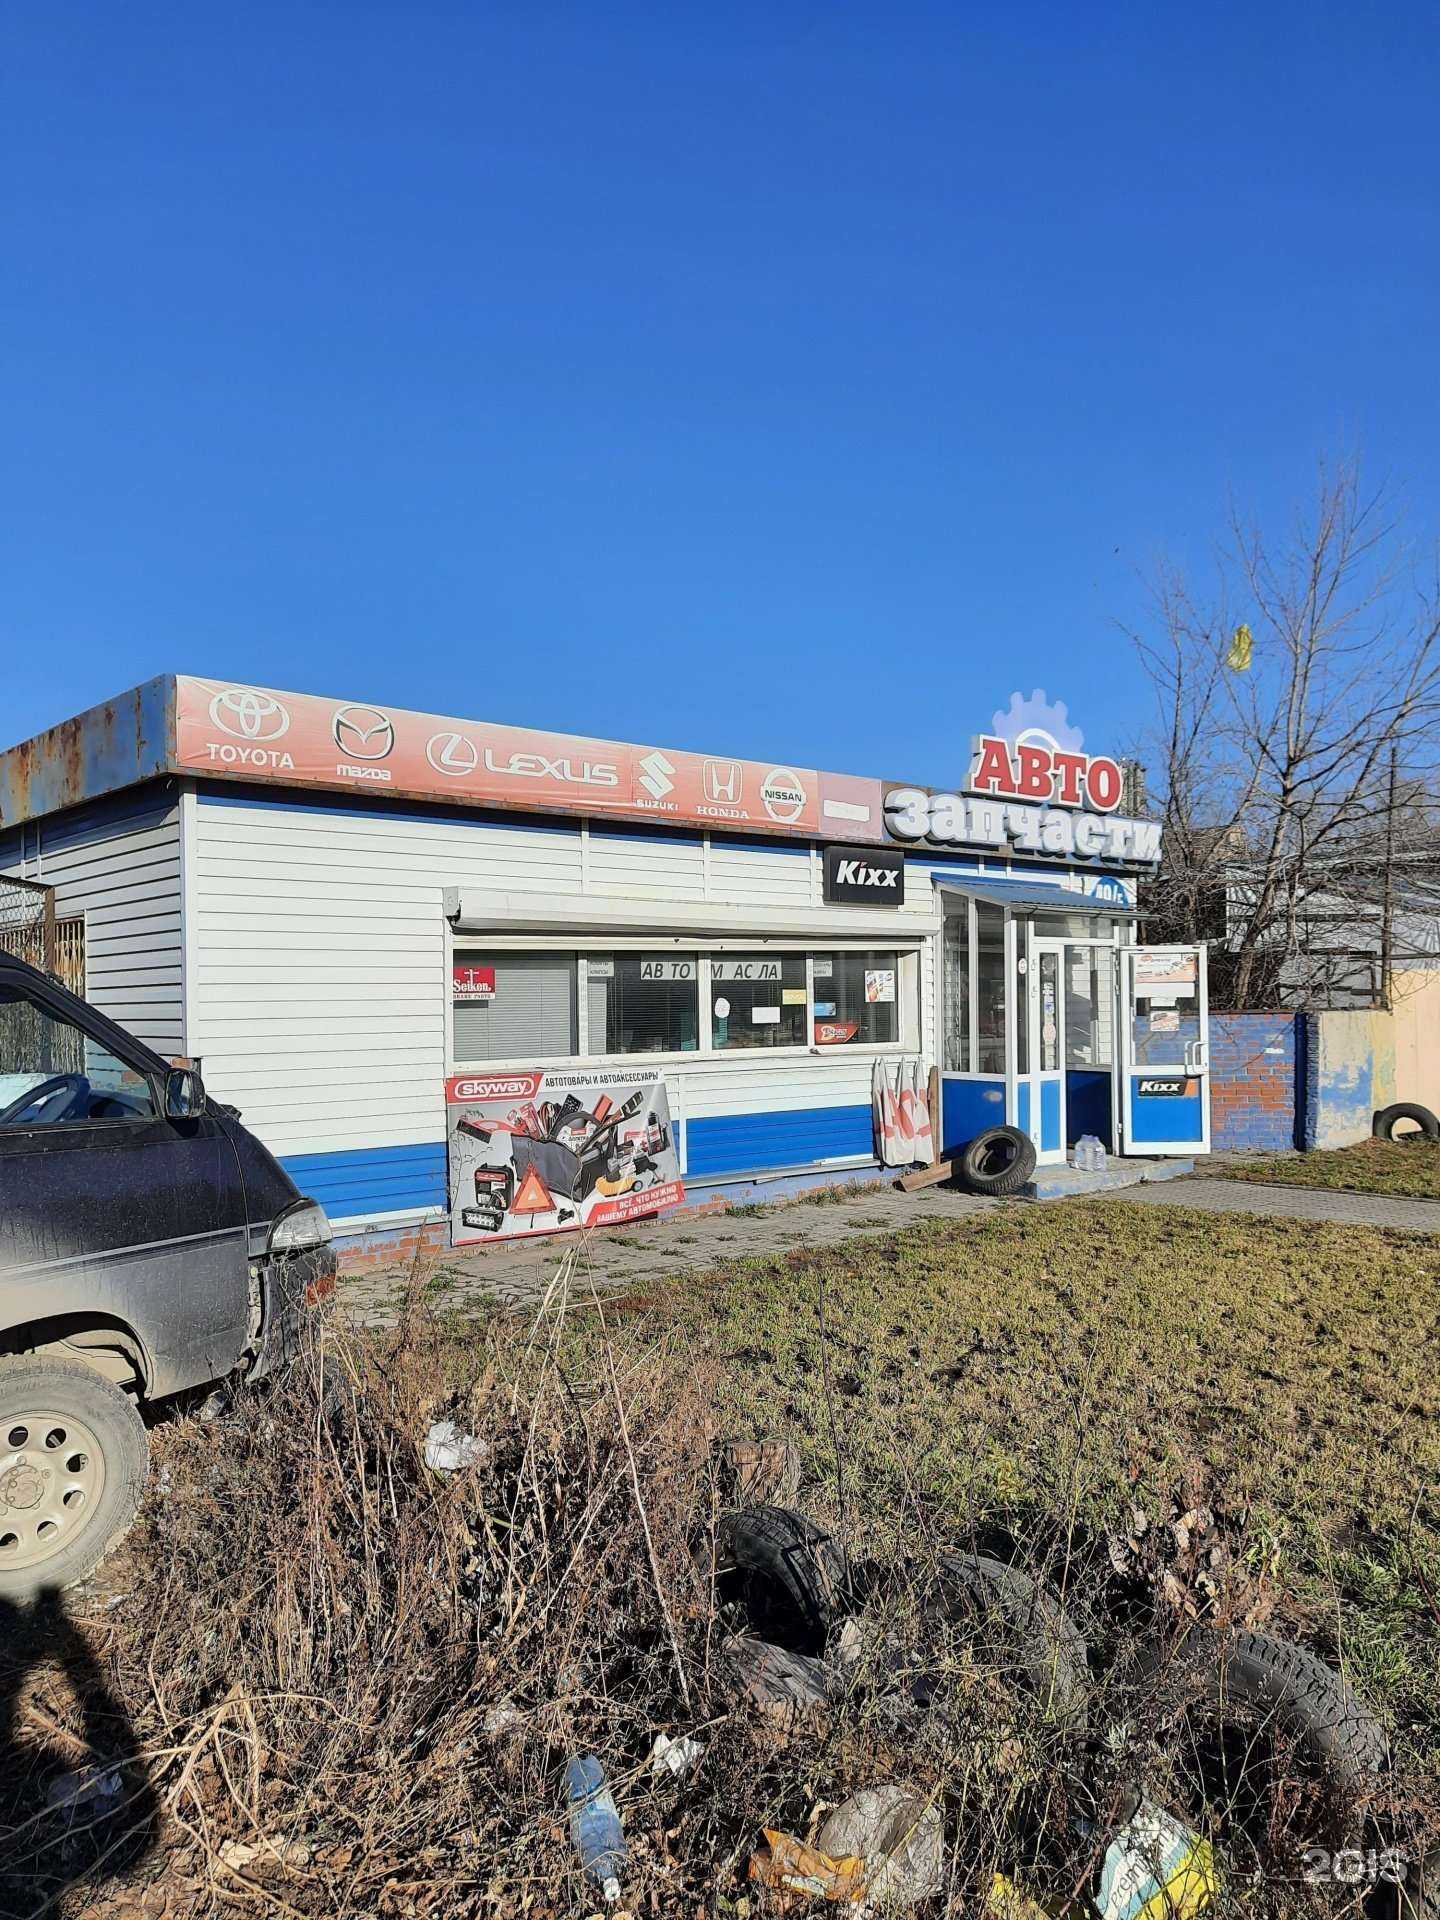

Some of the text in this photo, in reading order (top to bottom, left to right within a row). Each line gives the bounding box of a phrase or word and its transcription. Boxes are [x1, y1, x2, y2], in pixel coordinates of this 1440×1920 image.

[206, 743, 295, 769] TOYOTA
[484, 748, 619, 786] LEXUS
[972, 737, 1122, 810] АВТО
[764, 789, 802, 802] NISSAN
[635, 799, 679, 811] SUZUKI
[696, 805, 750, 819] HONDA
[836, 860, 900, 887] Kixx
[545, 1072, 659, 1087] АВТОТОВАРЫ И АВТОАКСЕССУАРЫ
[1140, 1080, 1181, 1092] Kixx
